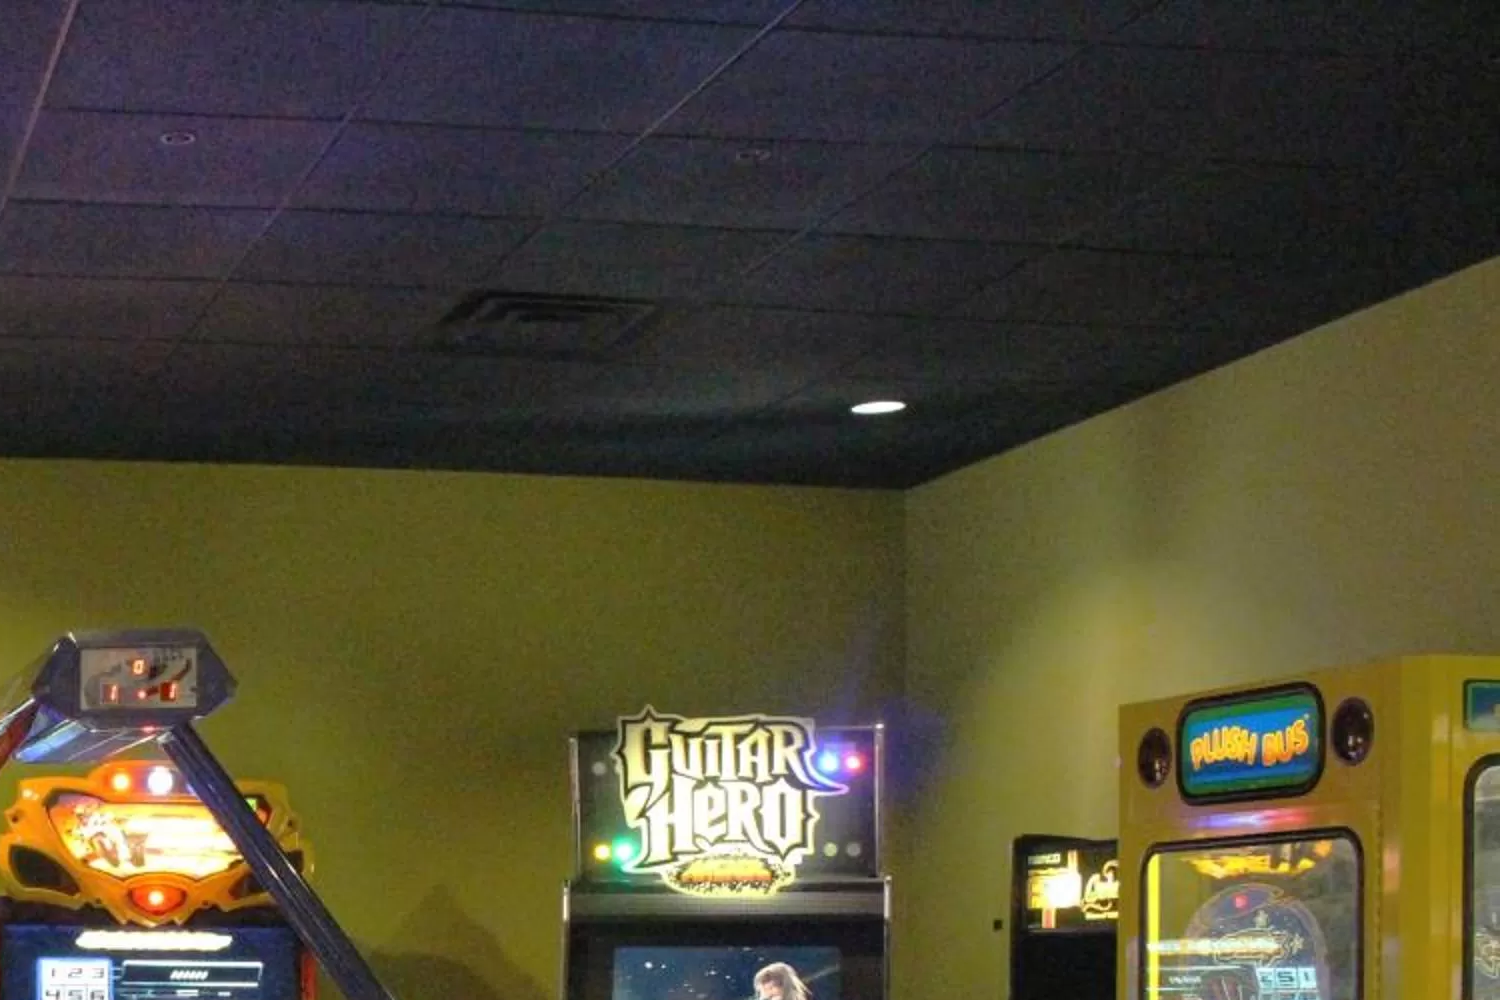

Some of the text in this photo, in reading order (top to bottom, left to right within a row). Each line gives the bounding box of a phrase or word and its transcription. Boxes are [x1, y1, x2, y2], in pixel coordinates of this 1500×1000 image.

[620, 716, 830, 796] GUITAR
[1190, 719, 1309, 771] PLUSH BUS
[625, 774, 810, 866] HERO
[45, 990, 105, 1000] 4 5 6
[67, 967, 83, 978] 2
